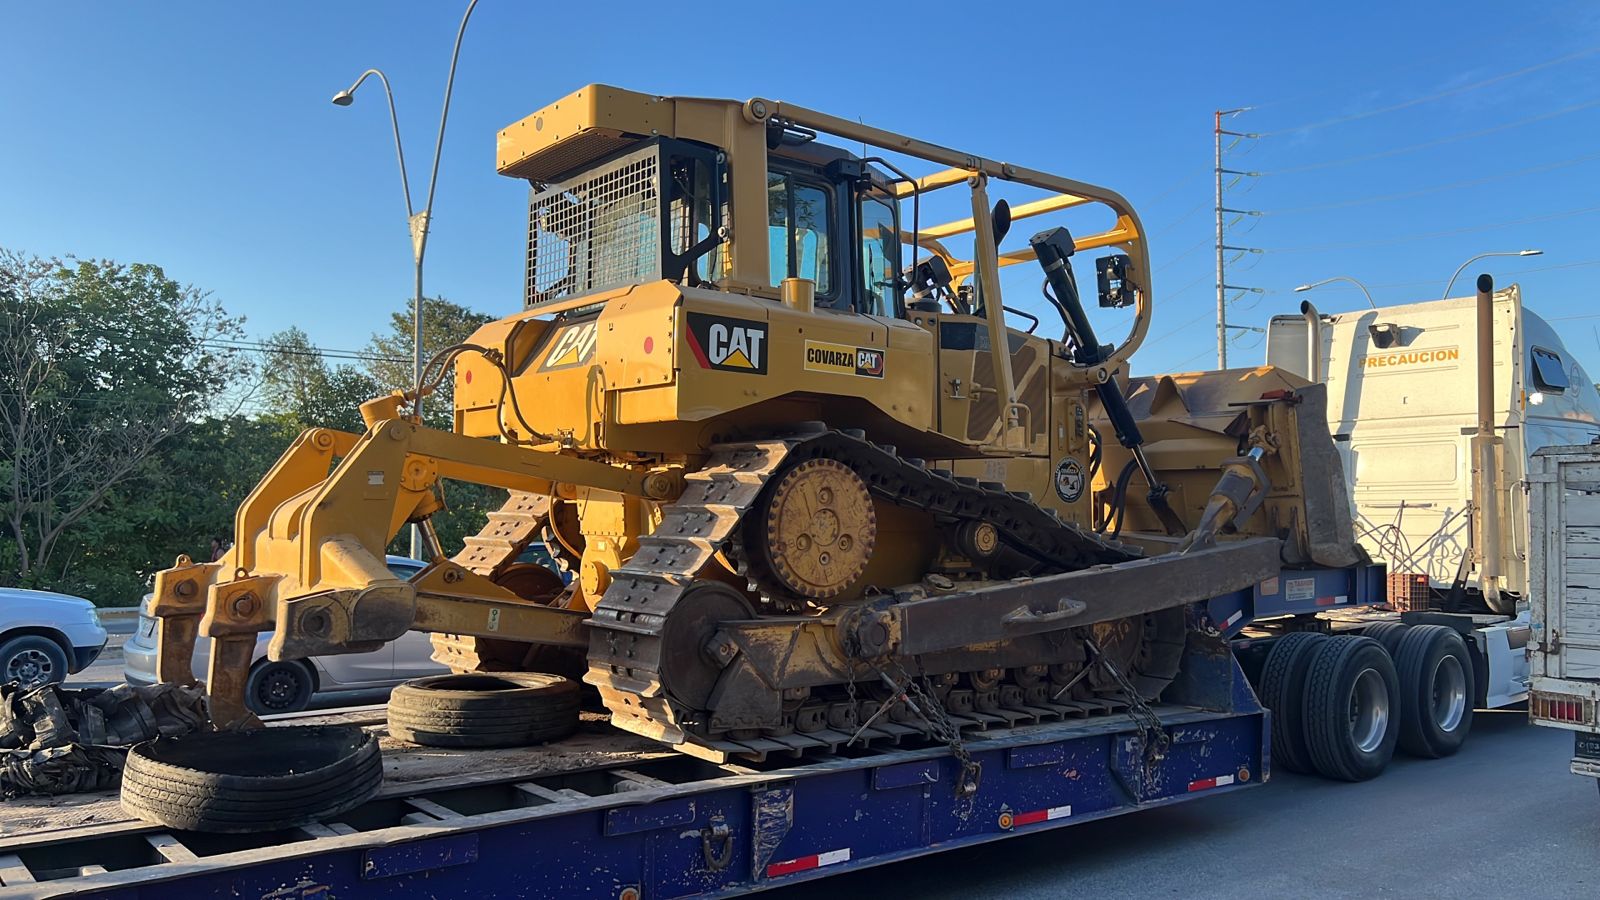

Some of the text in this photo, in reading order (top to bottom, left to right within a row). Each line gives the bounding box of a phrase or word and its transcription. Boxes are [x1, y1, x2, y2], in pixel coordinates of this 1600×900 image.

[708, 323, 764, 369] CAT
[807, 348, 877, 369] COVARZA CAT
[1358, 349, 1459, 368] PRECAUCION
